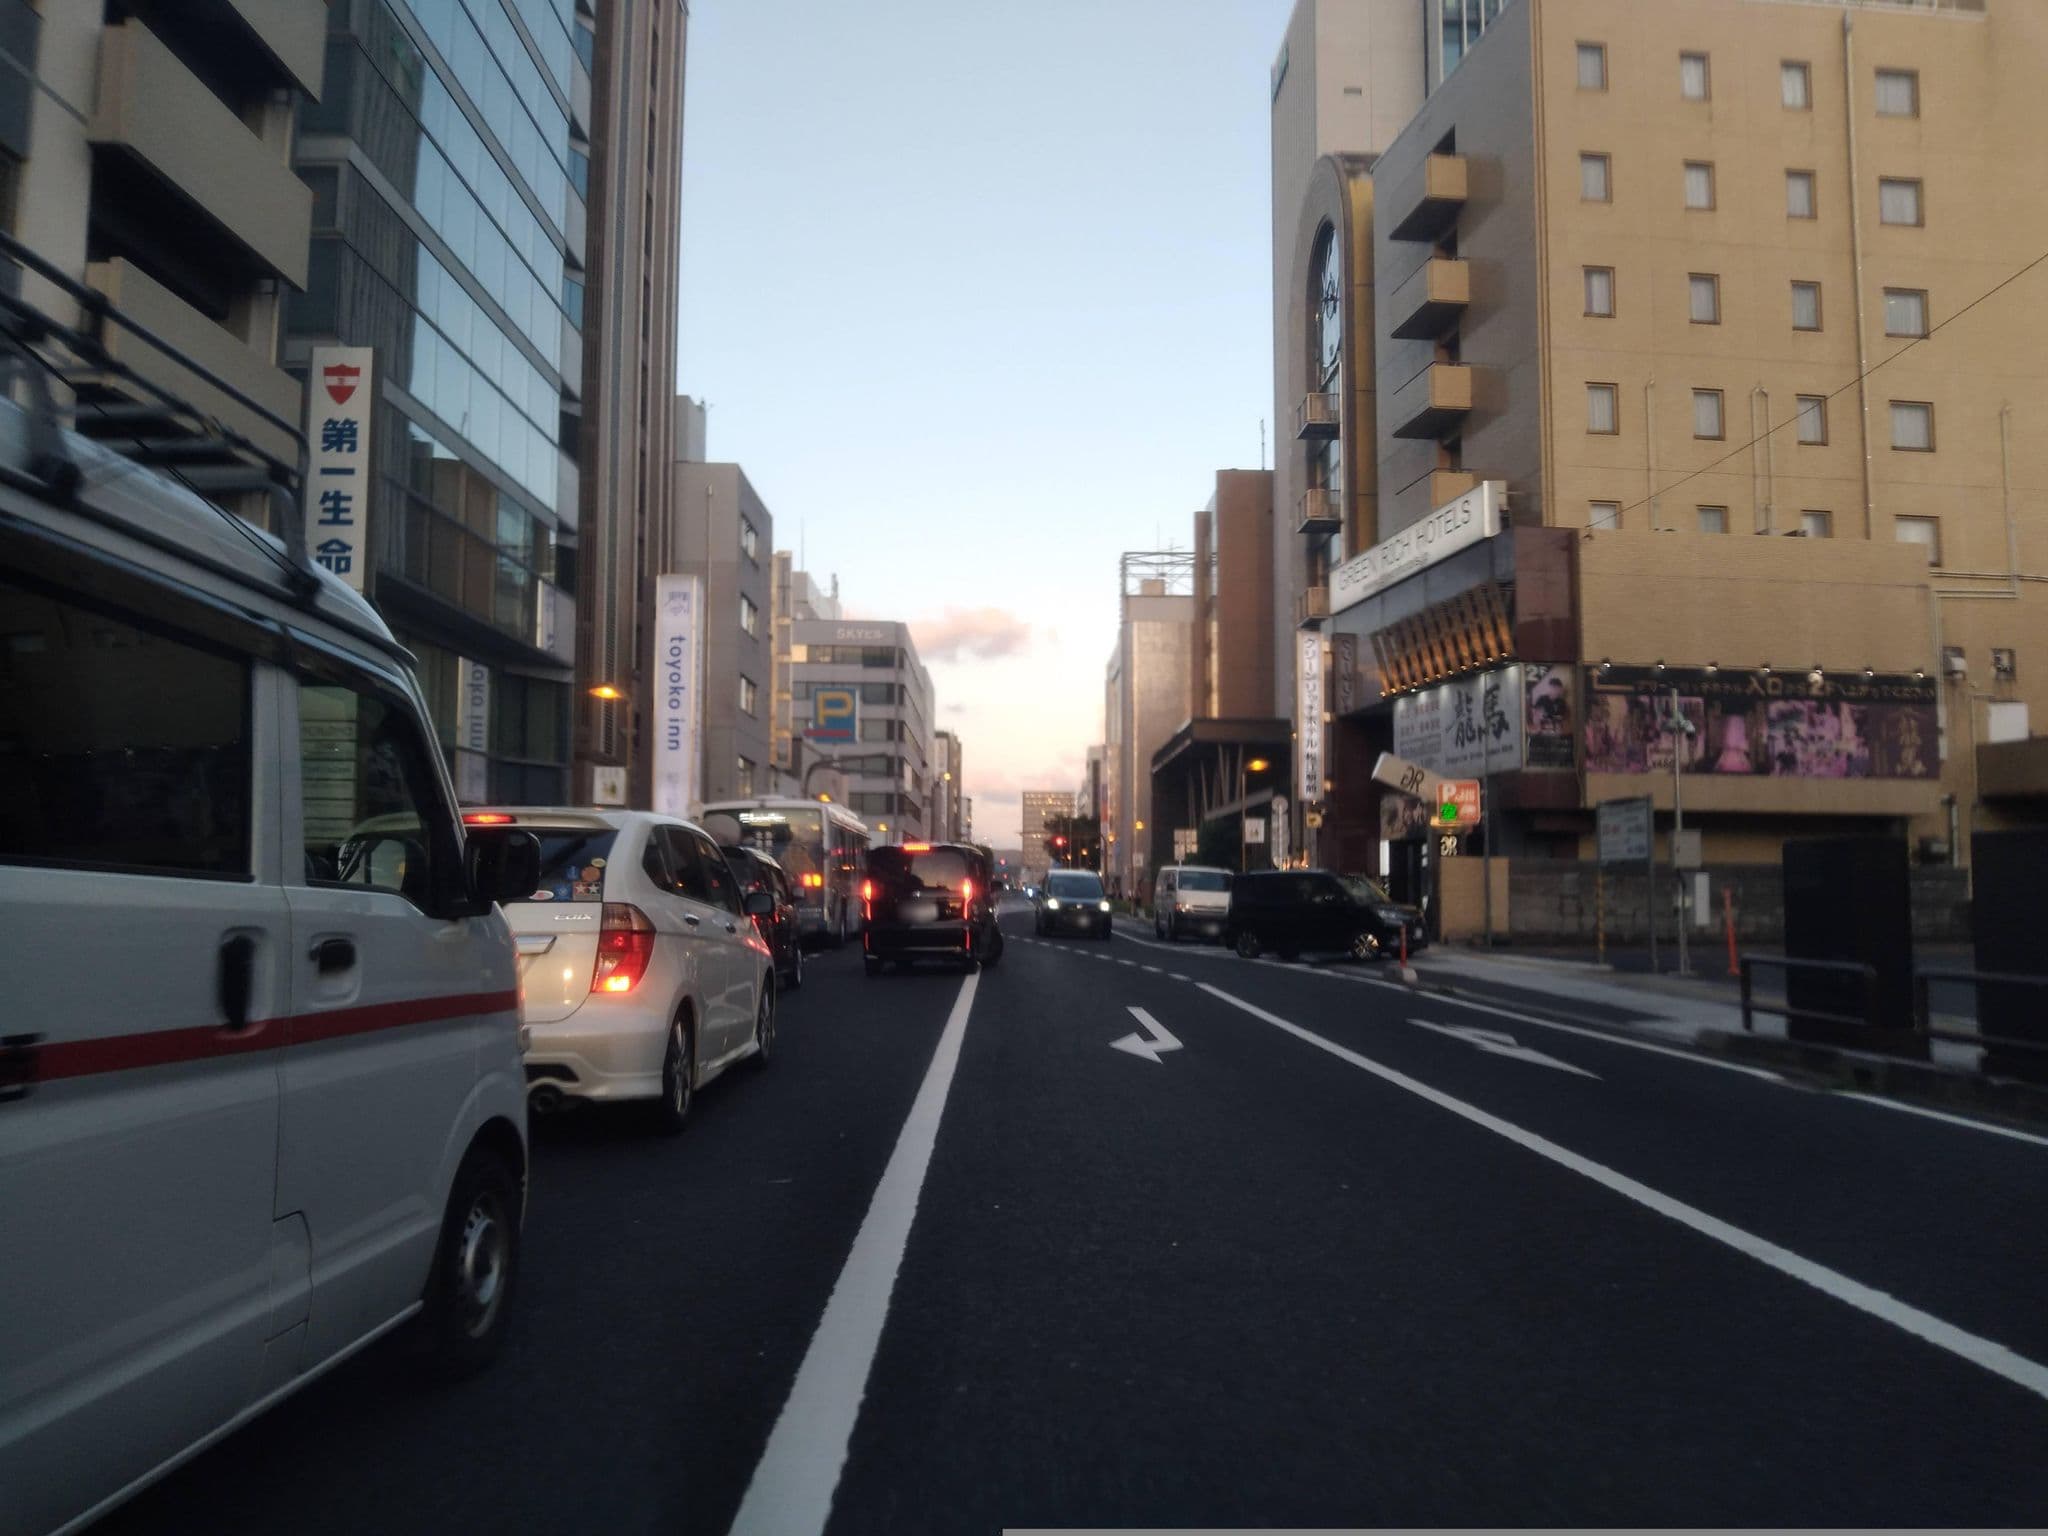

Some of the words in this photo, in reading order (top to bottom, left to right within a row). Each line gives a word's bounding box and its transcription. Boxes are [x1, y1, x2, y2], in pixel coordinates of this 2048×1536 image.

[316, 418, 358, 575] 第一生命
[1338, 553, 1378, 591] GREEN
[1380, 536, 1411, 568] RICH
[1415, 499, 1472, 549] HOTELS
[666, 633, 687, 710] toyoko
[816, 691, 853, 726] P
[668, 717, 686, 751] inn
